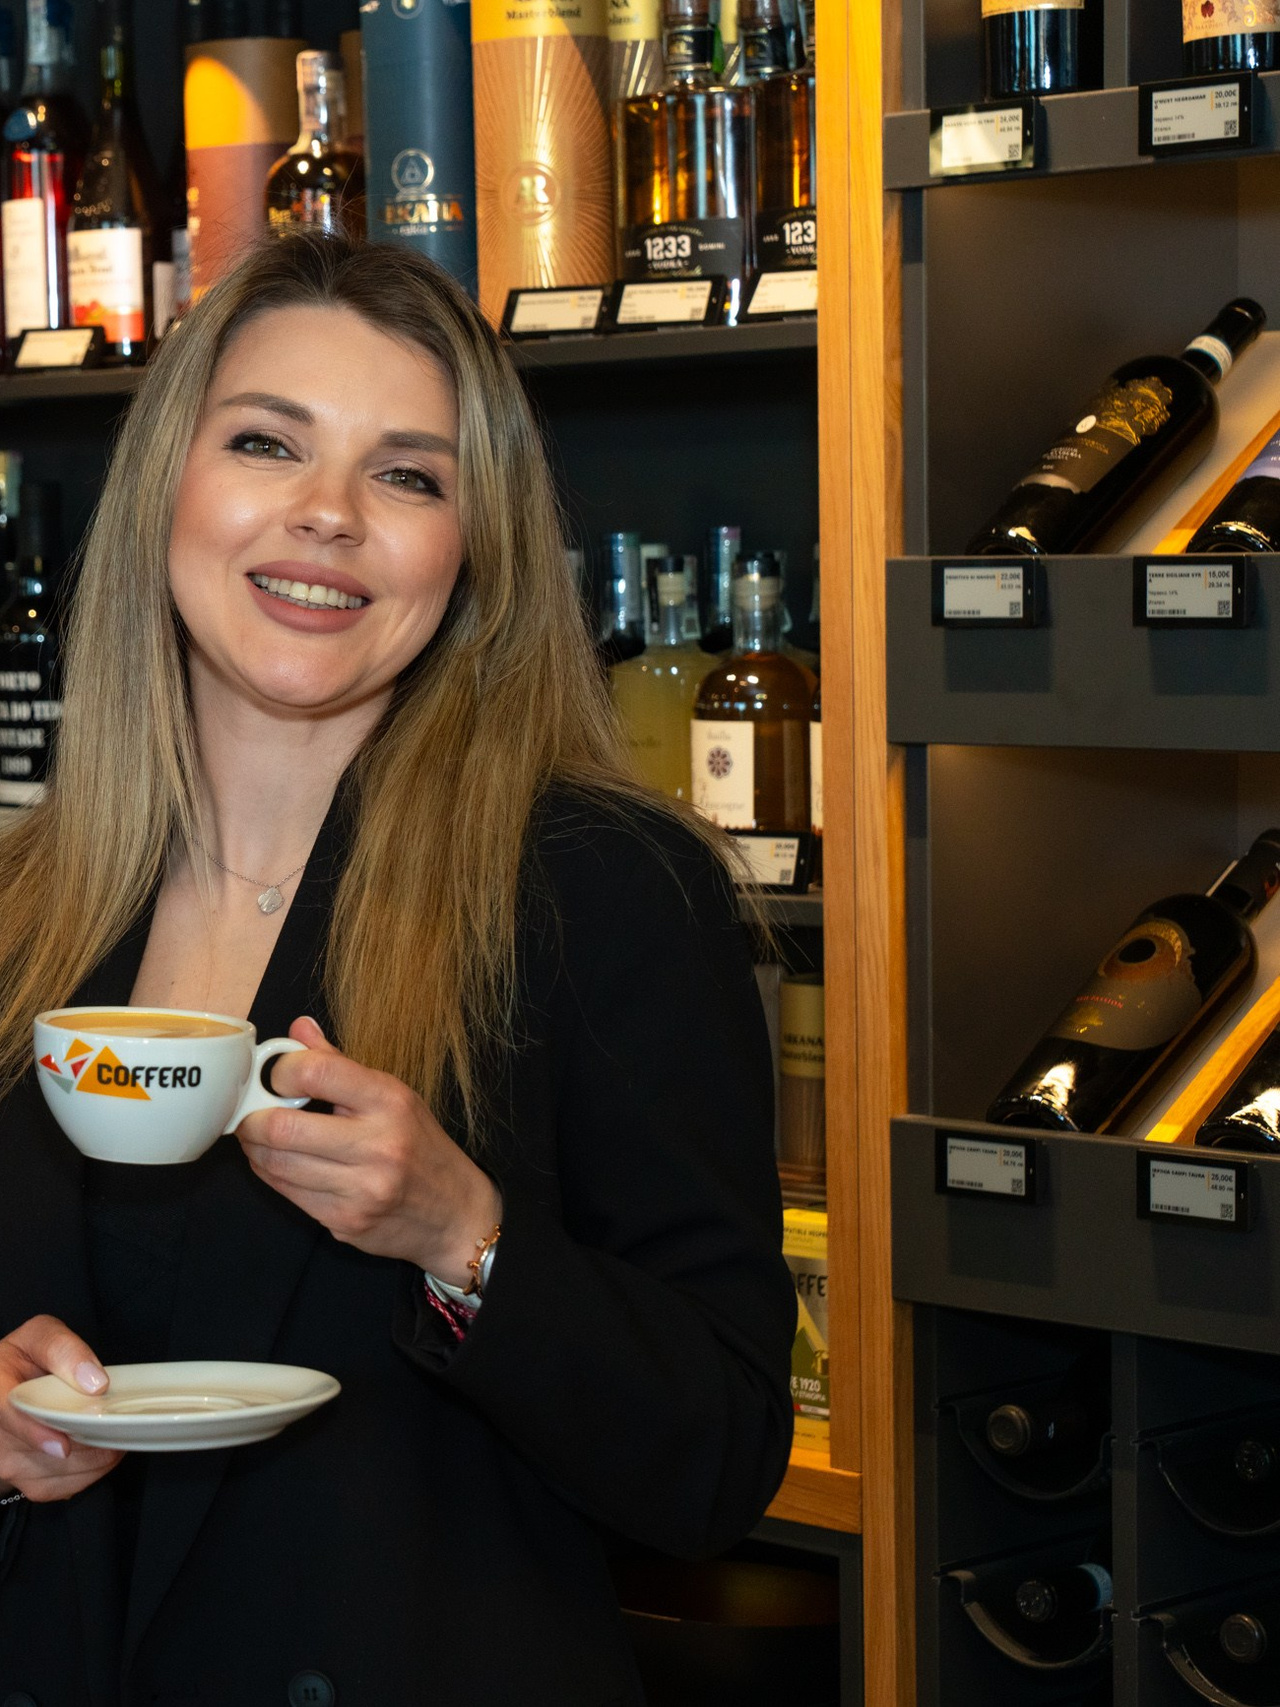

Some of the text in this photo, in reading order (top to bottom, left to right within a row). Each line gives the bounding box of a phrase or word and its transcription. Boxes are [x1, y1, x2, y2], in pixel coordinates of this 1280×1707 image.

[644, 234, 691, 261] 1233
[97, 1063, 201, 1088] COFFERO
[799, 1377, 821, 1393] 1920
